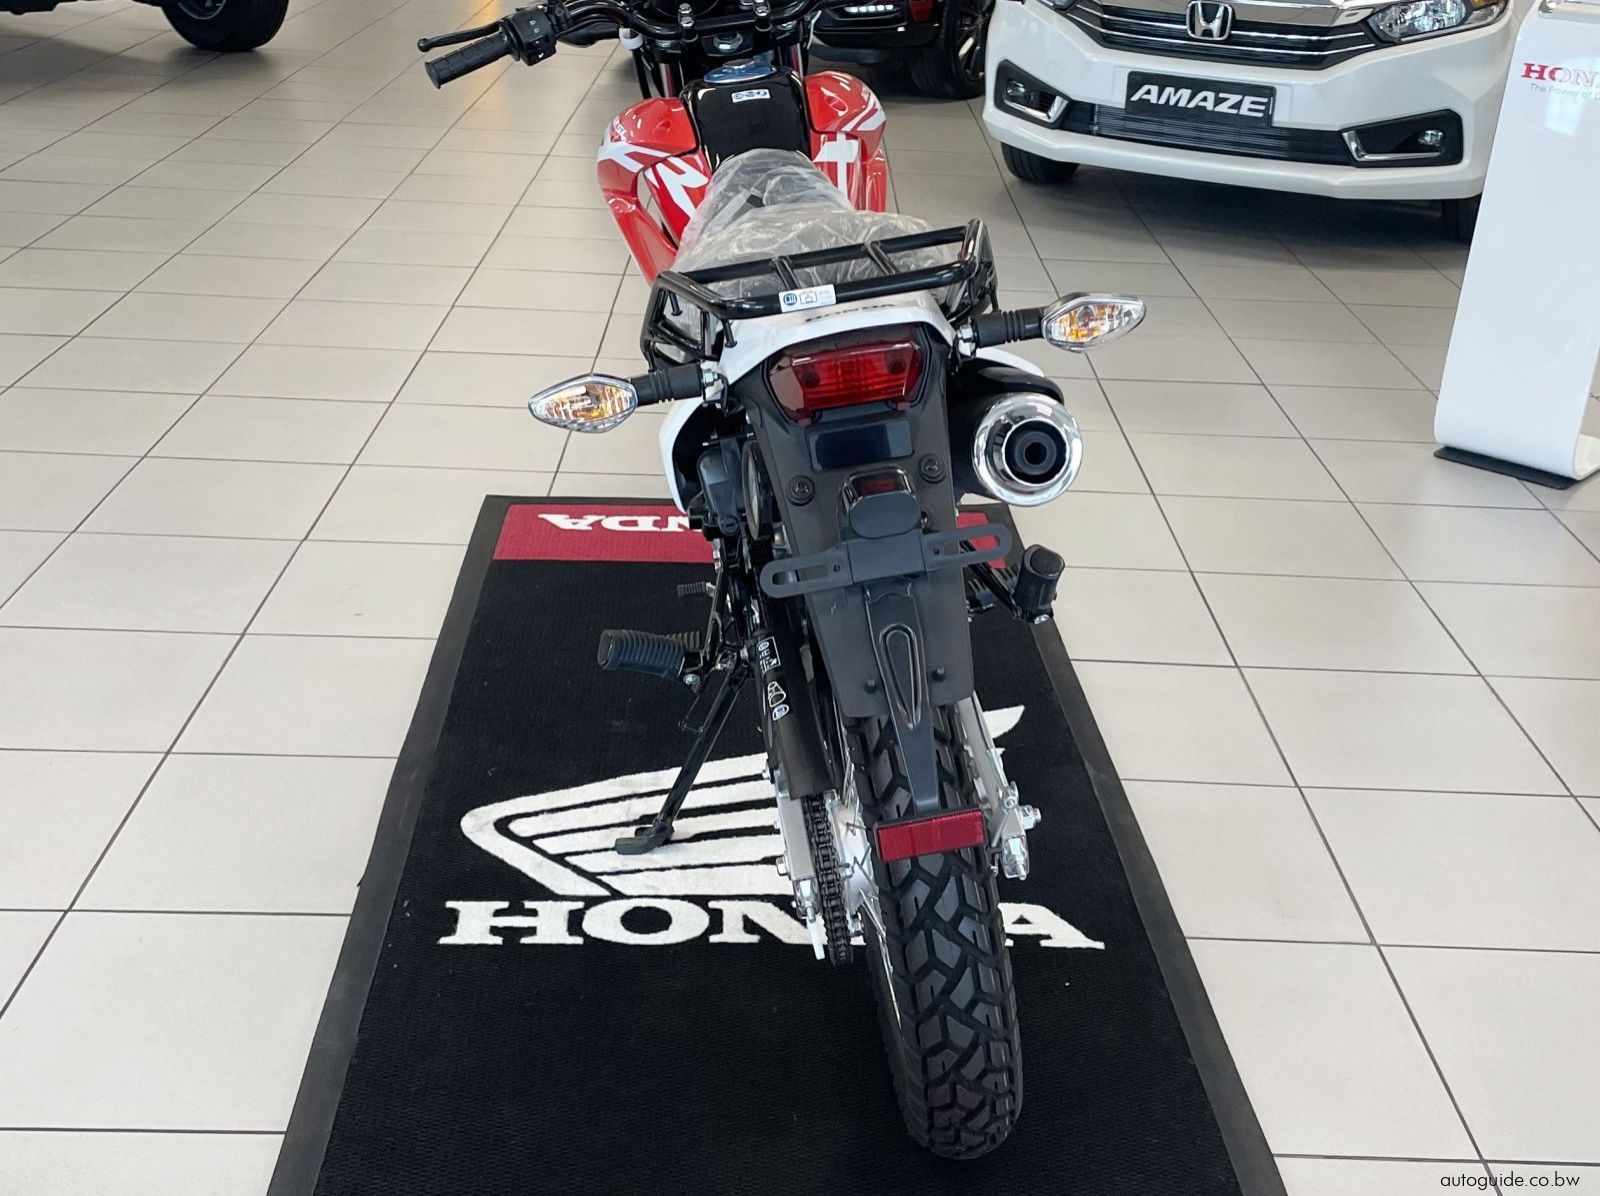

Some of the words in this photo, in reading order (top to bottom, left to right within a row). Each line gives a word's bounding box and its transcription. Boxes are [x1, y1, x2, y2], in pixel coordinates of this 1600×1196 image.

[1521, 62, 1600, 88] HON
[1530, 83, 1547, 93] The
[1130, 84, 1268, 117] AMAZE
[537, 513, 703, 533] NDA
[438, 897, 1105, 950] HONA
